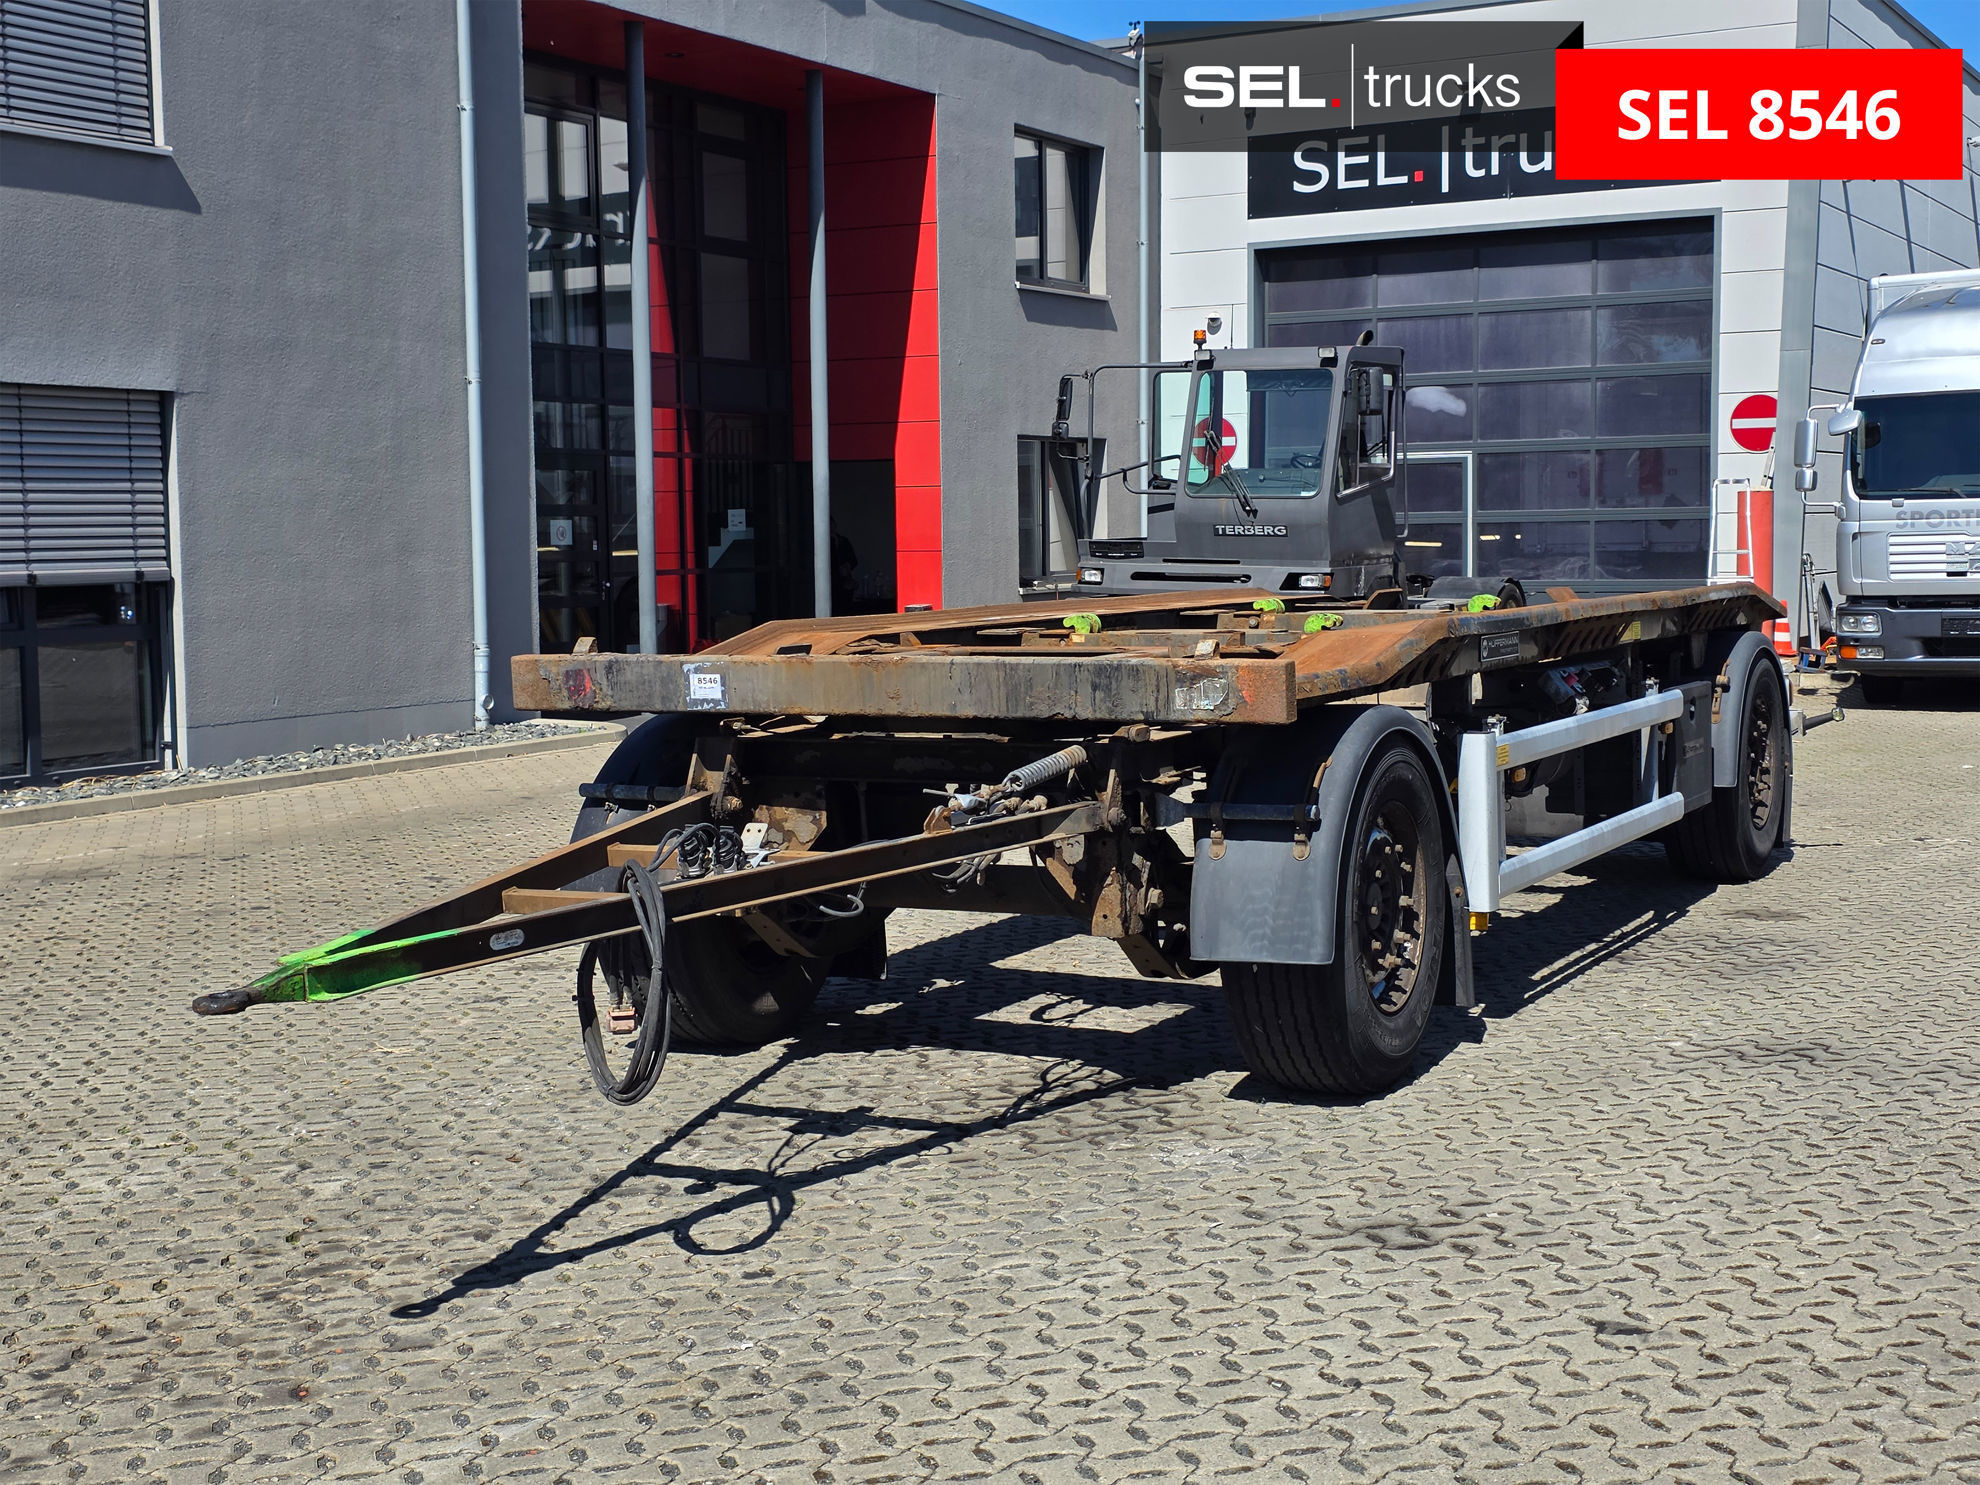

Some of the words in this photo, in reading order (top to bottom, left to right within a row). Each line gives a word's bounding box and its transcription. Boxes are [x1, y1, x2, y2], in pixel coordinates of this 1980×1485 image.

[1293, 134, 1424, 193] SEL.
[1215, 525, 1287, 535] TERBERG
[697, 677, 718, 685] 8546
